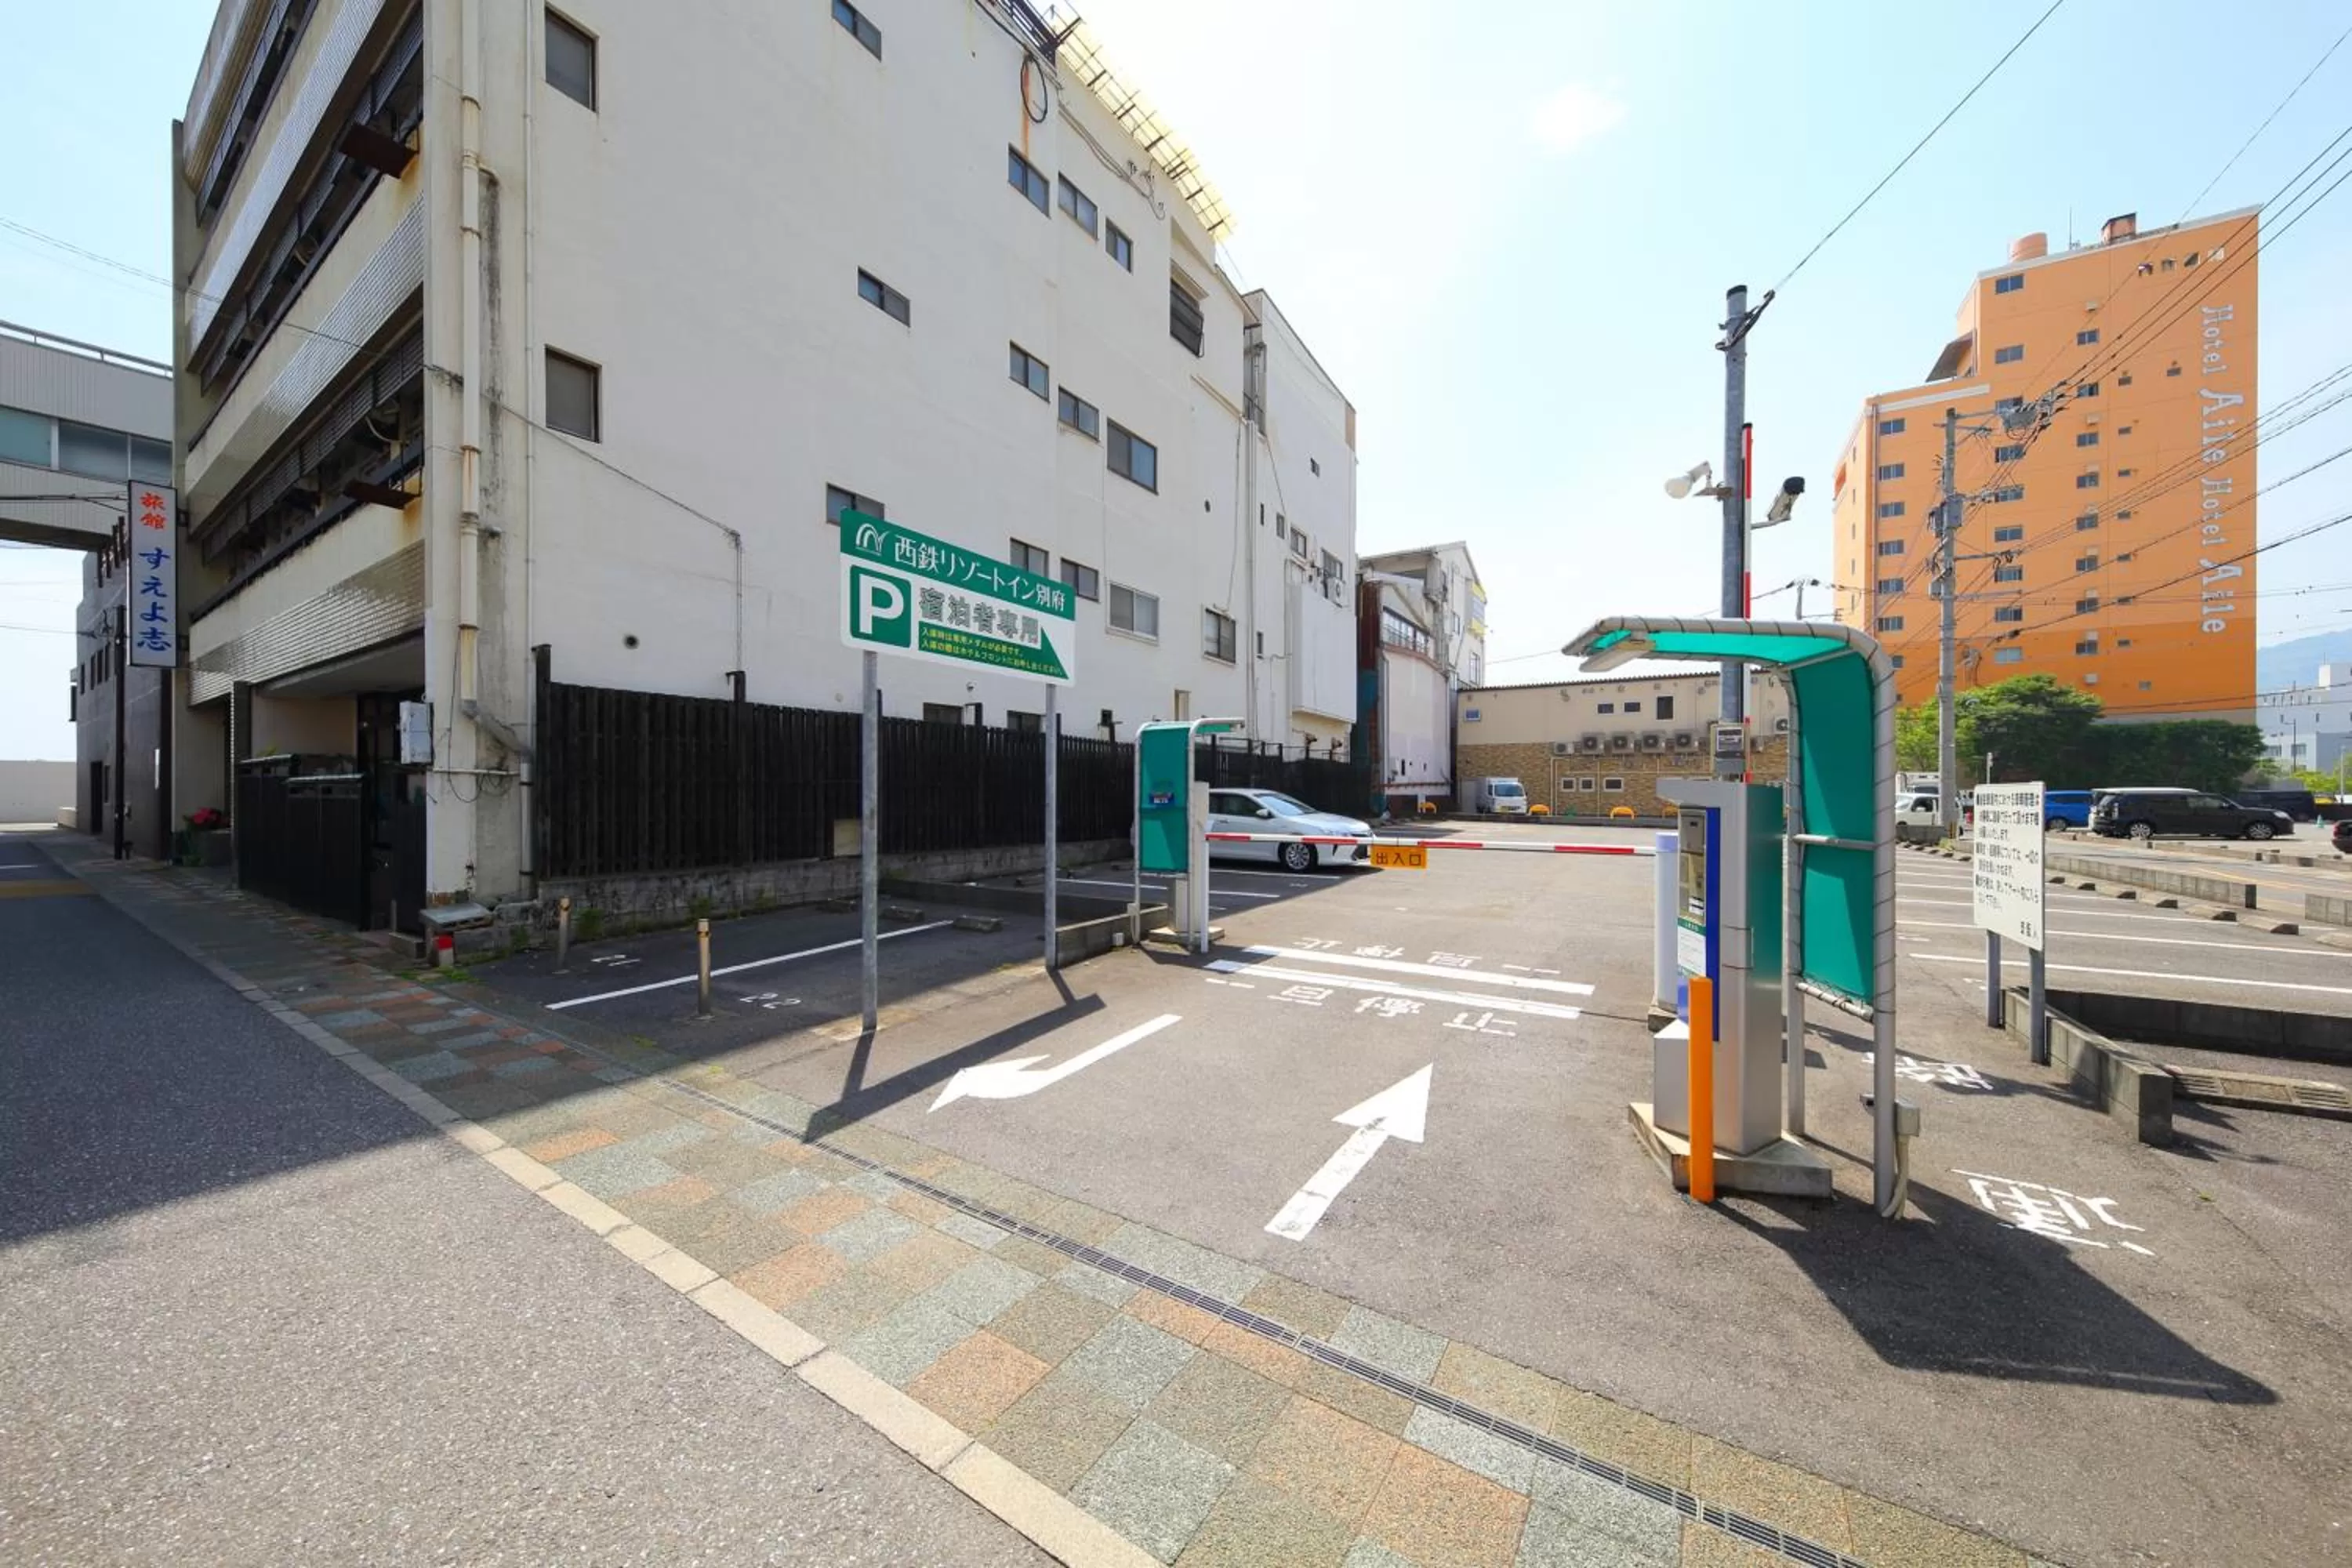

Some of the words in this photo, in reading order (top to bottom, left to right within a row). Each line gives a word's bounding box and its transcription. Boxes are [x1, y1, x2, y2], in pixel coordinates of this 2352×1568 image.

[2201, 304, 2234, 376] Hotel
[2199, 388, 2245, 463] Aile
[140, 492, 167, 530] 旅館
[2201, 477, 2234, 547] Hotel
[137, 547, 172, 652] すえよ志
[859, 573, 904, 634] P
[895, 532, 1065, 612] 西鉄リゾートイン別府
[2199, 557, 2244, 633] Aile
[919, 586, 1039, 644] 宿泊者専用
[1376, 852, 1421, 866] 出入口
[1205, 978, 1517, 1036] 一旦停止
